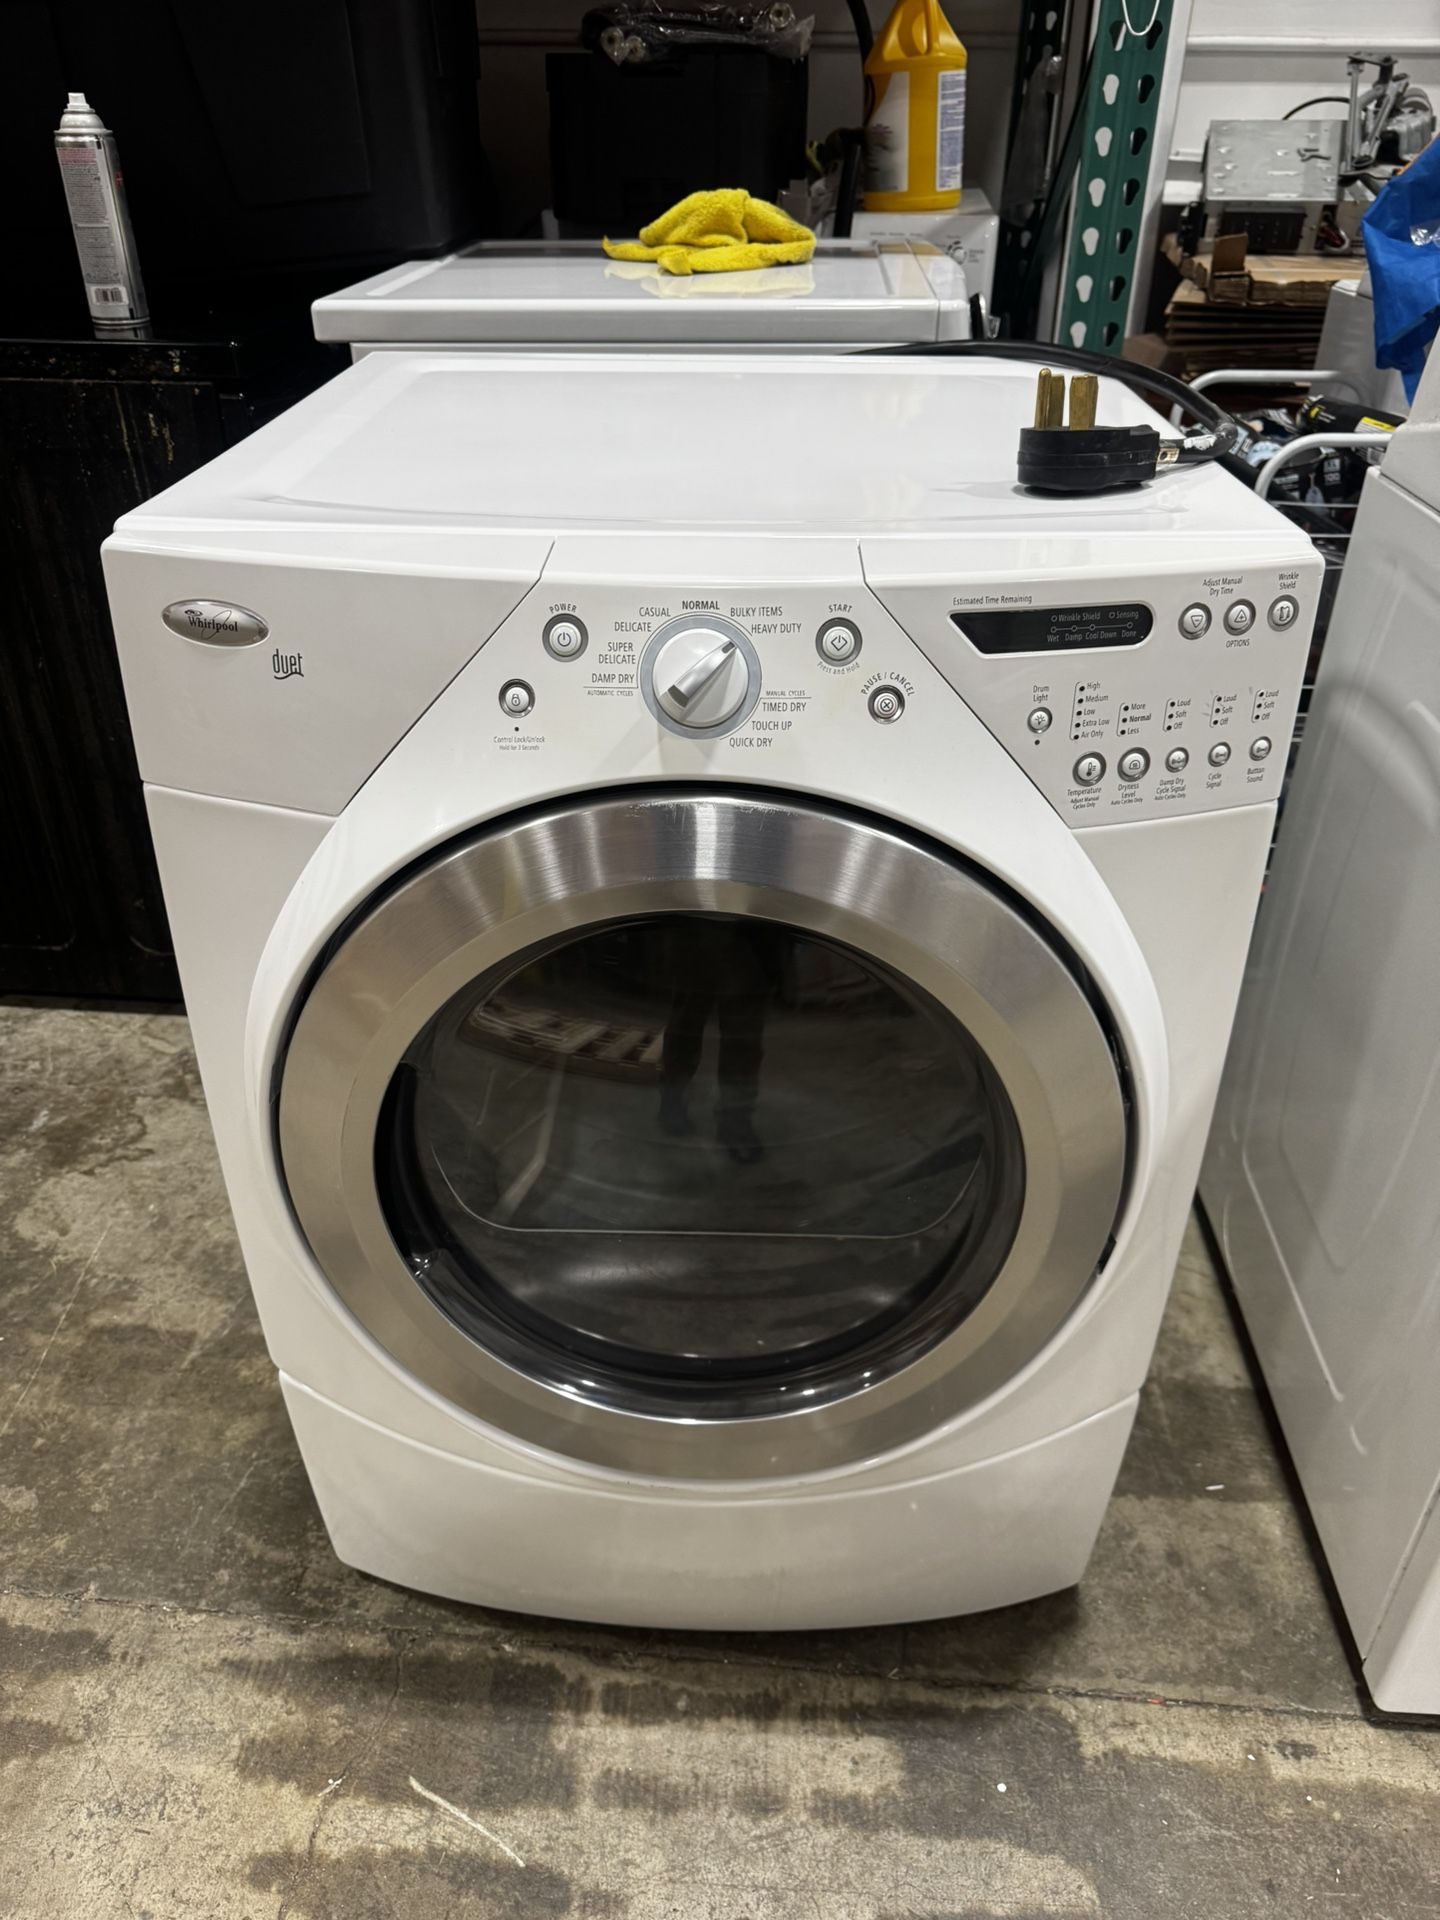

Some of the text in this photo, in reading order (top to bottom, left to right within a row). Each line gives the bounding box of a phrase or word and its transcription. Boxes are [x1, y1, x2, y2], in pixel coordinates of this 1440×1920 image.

[1279, 572, 1299, 581] Wrinkle
[1202, 576, 1243, 587] Adjust Manual
[1280, 581, 1296, 590] Shield
[1209, 587, 1234, 597] Dry Time
[953, 595, 1032, 606] Estimated Time Remaining
[549, 603, 577, 613] POWER
[682, 601, 720, 610] NORMAL
[828, 604, 852, 613] START
[639, 607, 671, 617] CASUAL
[730, 606, 783, 617] BULKY ITEMS
[1116, 610, 1139, 620] Sensing
[1059, 612, 1101, 621] Wrinkle Shield
[188, 615, 238, 633] Whirlpool
[614, 622, 651, 632] DELICATE
[751, 623, 802, 634] HEAVY DUTY
[1047, 634, 1060, 643] Wet
[1065, 633, 1082, 642] Damp
[1085, 631, 1117, 640] Cool Down
[1121, 630, 1137, 638] Done
[608, 642, 633, 652] SUPER
[1226, 639, 1250, 648] OPTIONS
[272, 648, 303, 677] duet
[598, 654, 636, 664] DELICATE
[817, 661, 860, 675] Press and Hold
[591, 673, 635, 684] DAMP DRY
[861, 673, 882, 695] PAUSE
[889, 672, 915, 696] CANCEL
[1087, 682, 1101, 691] High
[1033, 685, 1050, 693] Drum
[1033, 694, 1048, 703] Light
[1085, 694, 1109, 702] Medium
[1223, 694, 1237, 702] Loud
[762, 702, 806, 712] TIMED DRY
[1177, 699, 1191, 707] Loud
[1175, 710, 1187, 718] Soft
[1222, 706, 1233, 714] Soft
[1129, 713, 1152, 722] Normal
[1261, 712, 1271, 720] Off
[752, 721, 792, 730] TOUCH UP
[1219, 717, 1229, 726] Off
[1091, 730, 1104, 738] Only
[493, 736, 514, 744] Control
[729, 738, 773, 747] QUICK DRY
[1208, 773, 1222, 781] Cycle
[1247, 775, 1263, 783] Sound
[1175, 778, 1185, 786] Dry
[1118, 783, 1139, 791] Dryness
[1156, 785, 1186, 794] Cycle Signal
[1067, 787, 1101, 797] Temperature
